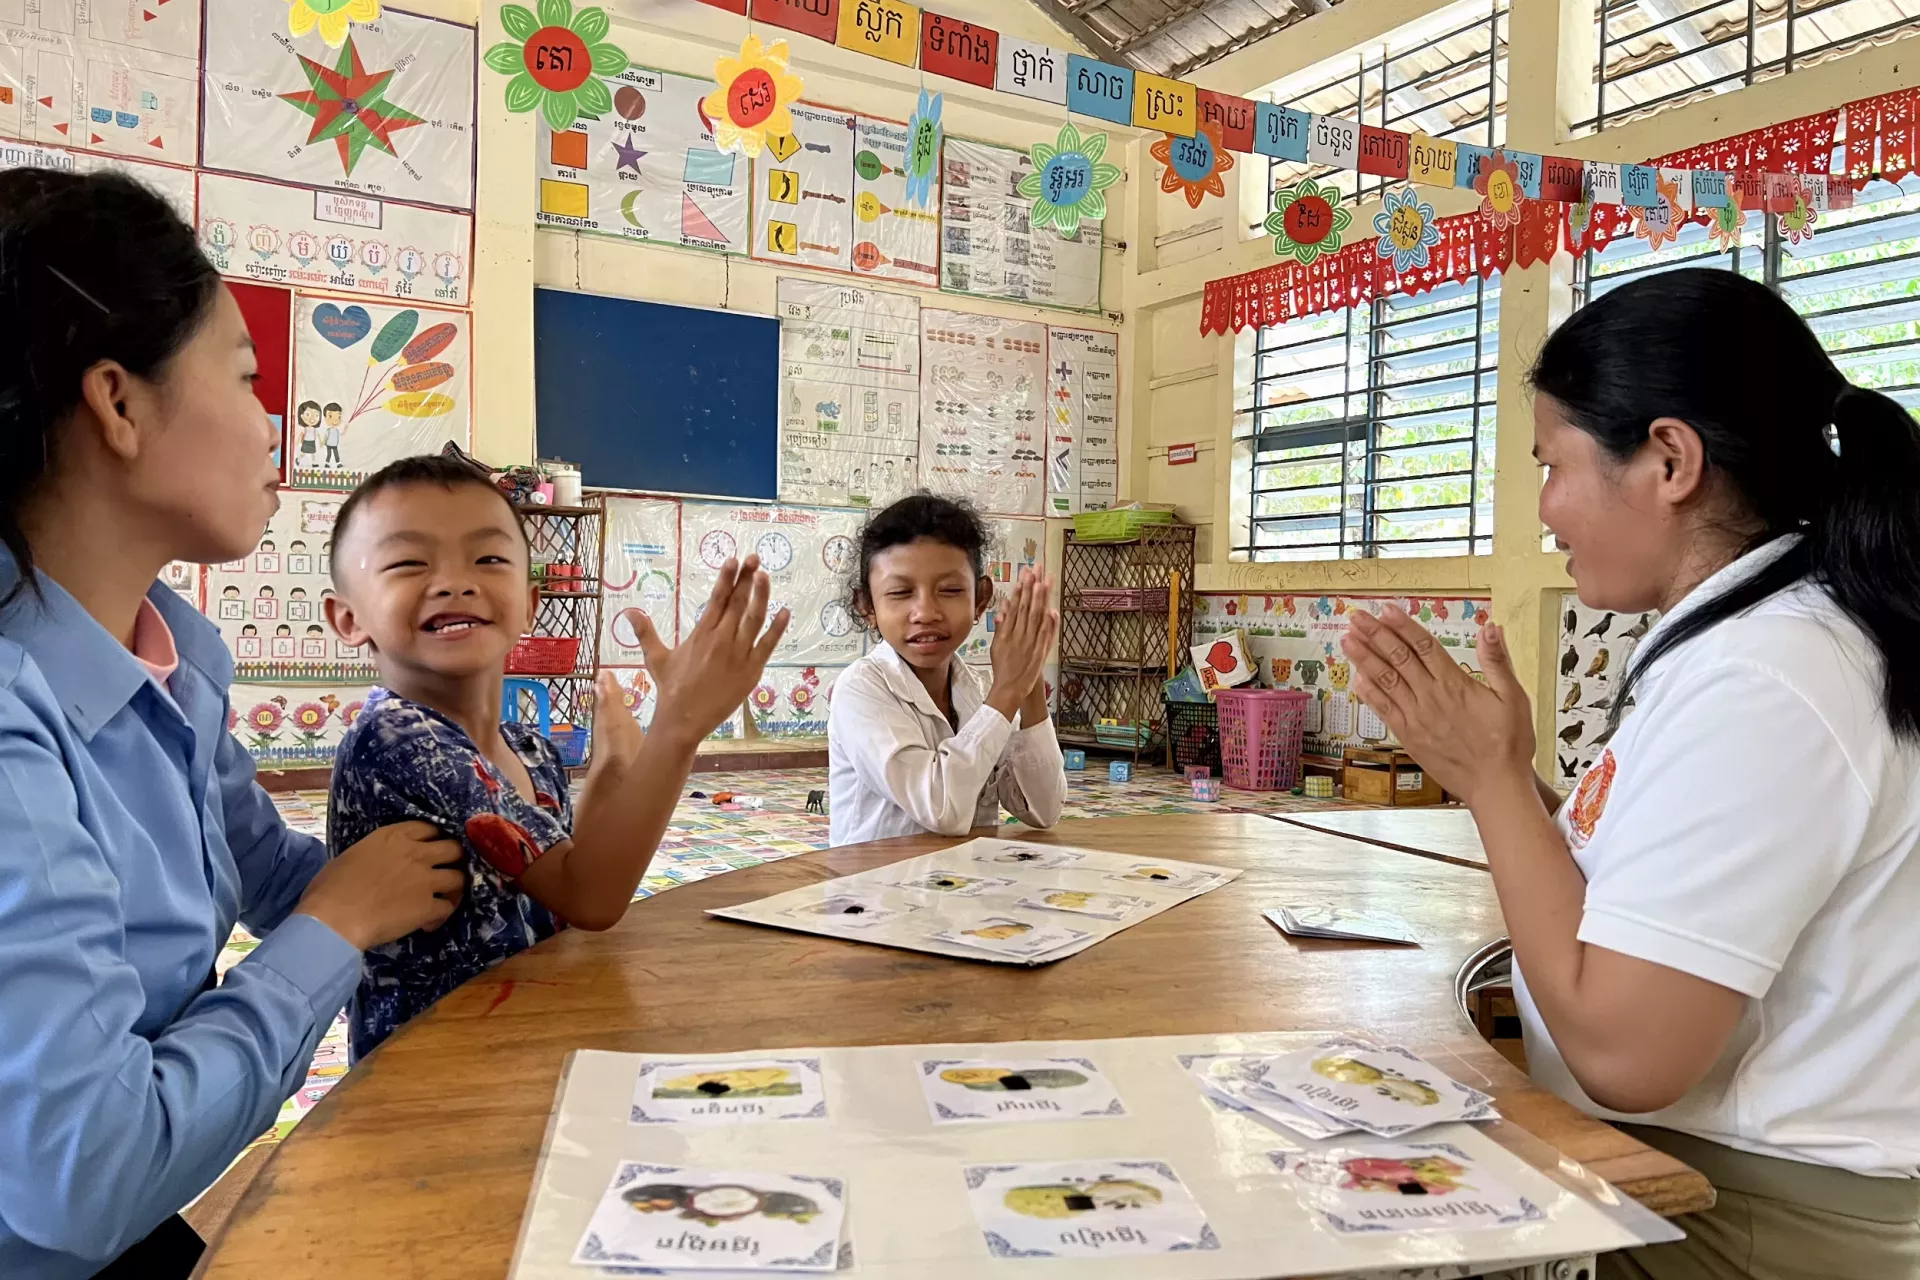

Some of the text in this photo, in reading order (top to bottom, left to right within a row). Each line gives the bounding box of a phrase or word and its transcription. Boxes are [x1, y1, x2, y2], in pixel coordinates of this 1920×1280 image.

[929, 16, 990, 66] ទំពាំង
[1012, 47, 1055, 87] ថ្នាក់
[1145, 87, 1183, 121] ស្រះ
[1267, 106, 1299, 143] ពូកែ
[1316, 116, 1353, 158] ចំនួន
[1363, 131, 1404, 169] តៅហ៊ូ
[1414, 144, 1453, 175] ស្វាយ
[1049, 165, 1085, 202] អ៊ូអរ
[1295, 199, 1320, 229] ដៃ
